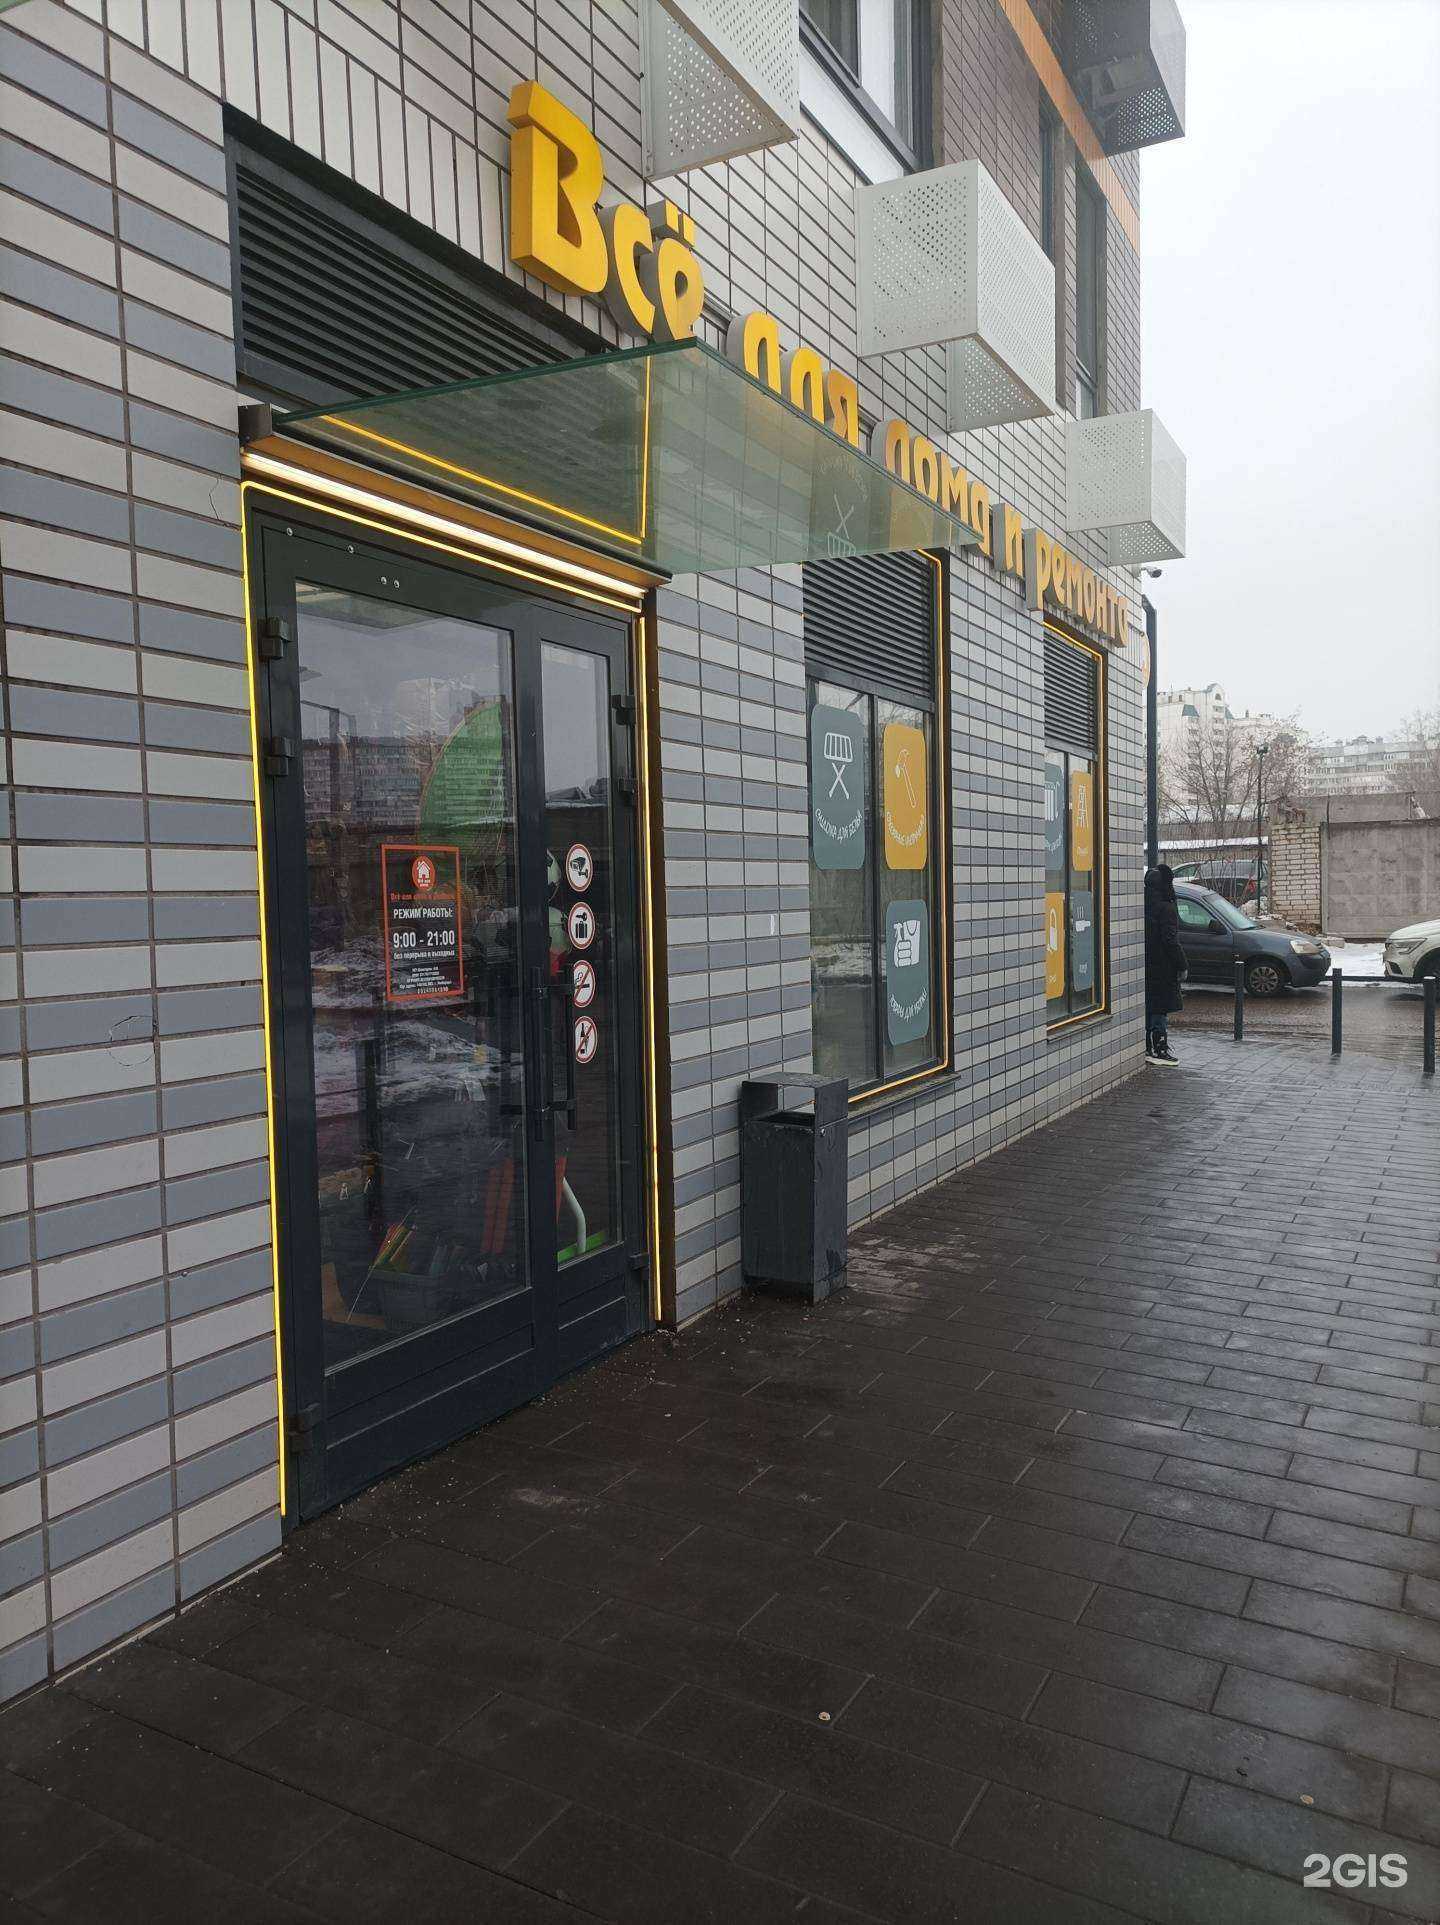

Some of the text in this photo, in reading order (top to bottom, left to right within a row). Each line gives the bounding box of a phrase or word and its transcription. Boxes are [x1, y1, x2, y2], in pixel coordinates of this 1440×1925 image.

[507, 80, 704, 341] Всё
[871, 418, 990, 556] дома
[993, 502, 1024, 582] и
[1025, 527, 1129, 648] ремонта
[393, 907, 453, 919] РЕЖИМ РАБОТЫ:
[393, 932, 416, 948] 9:00
[427, 930, 455, 946] 21:00
[393, 952, 403, 960] без
